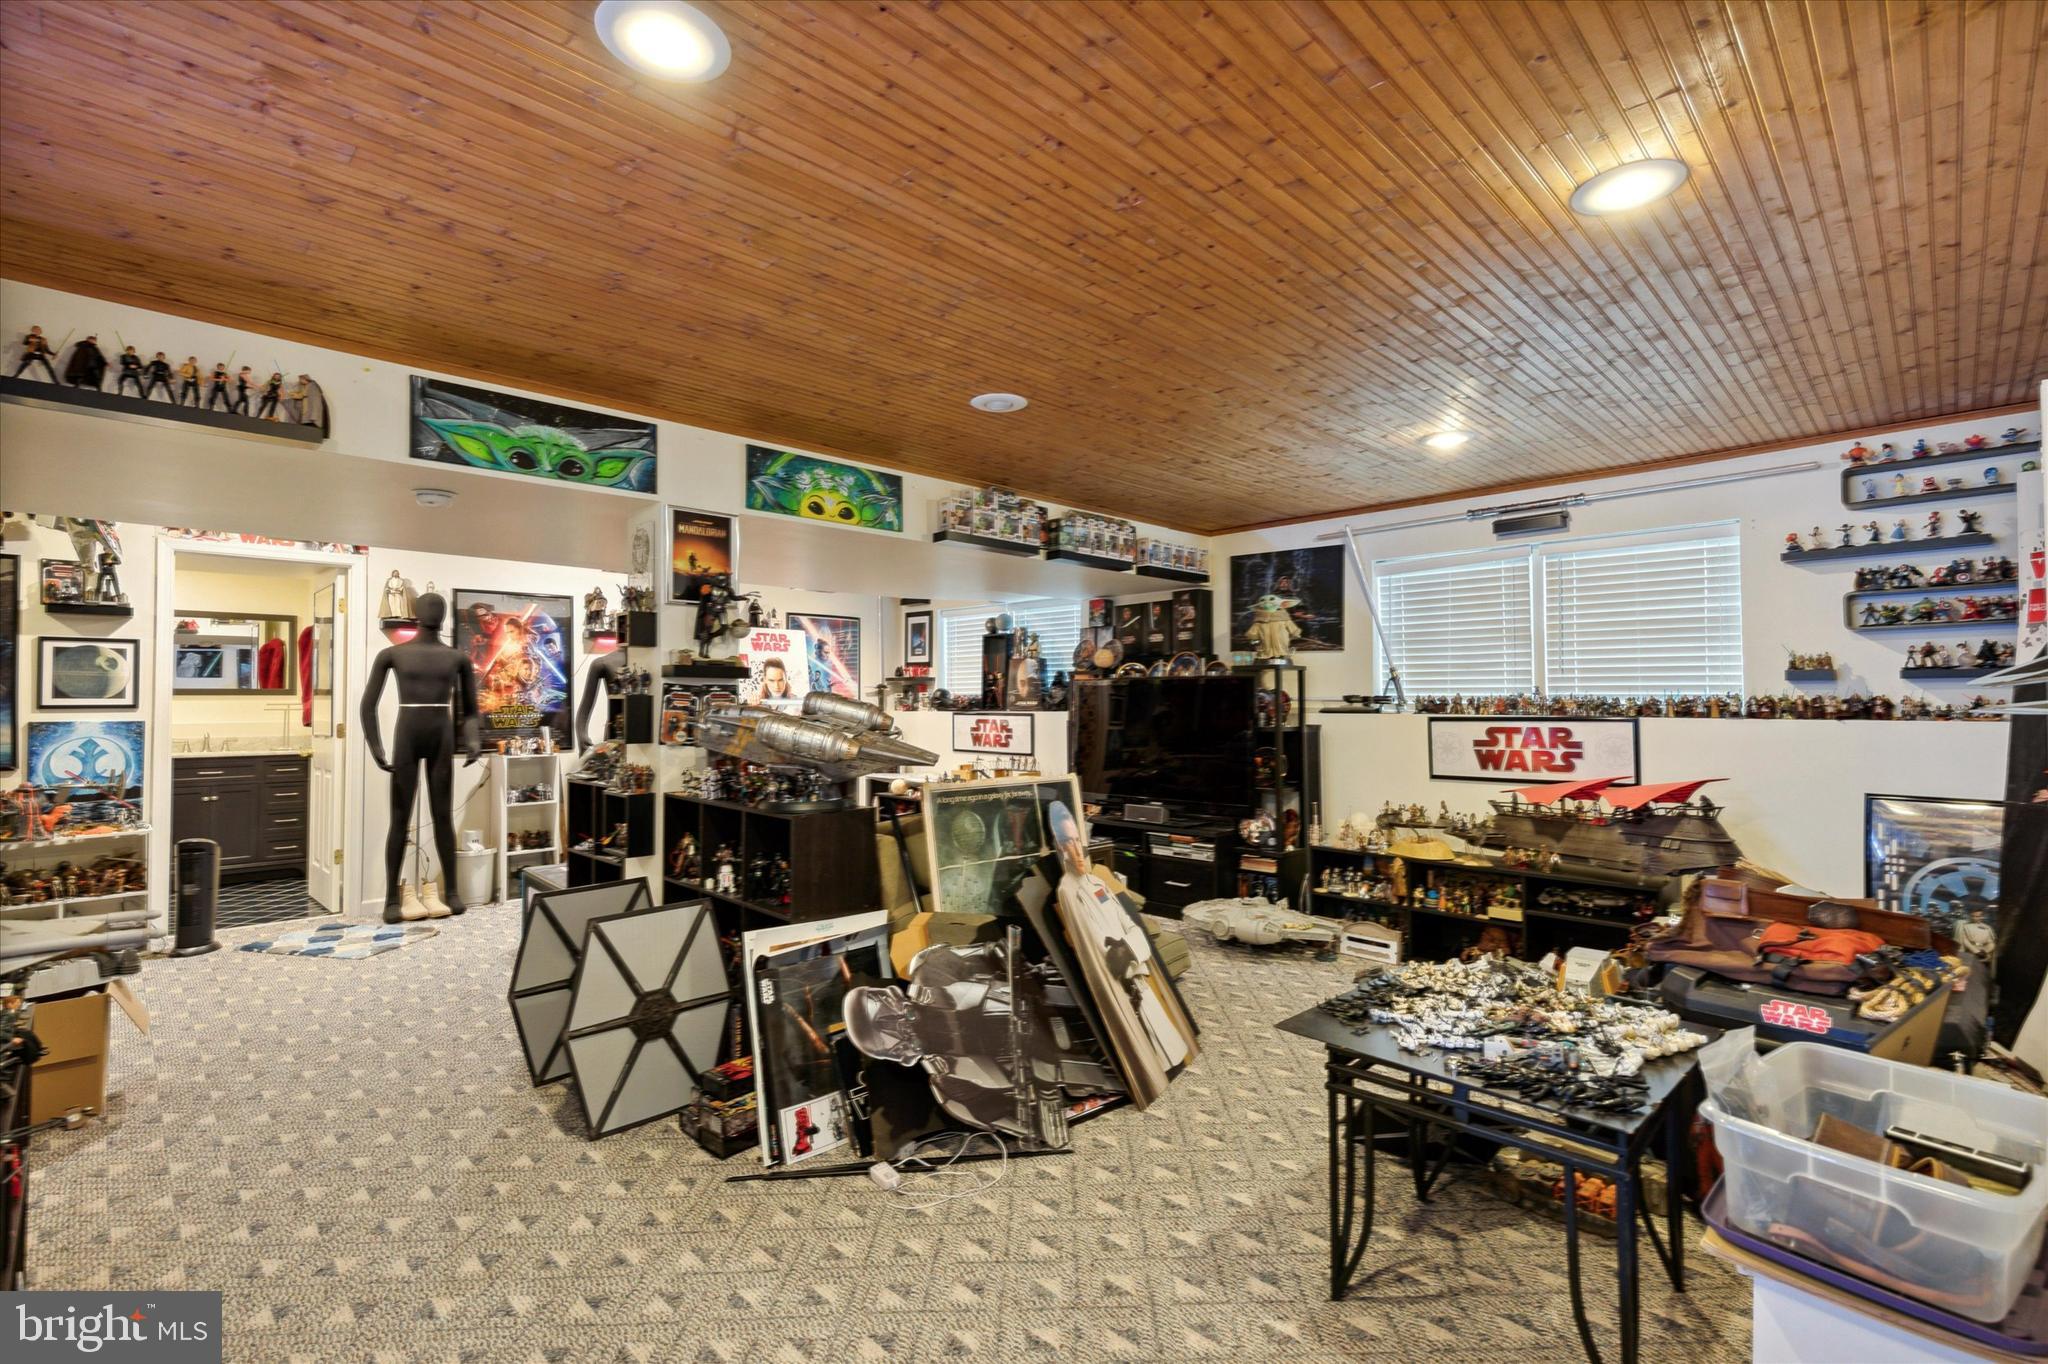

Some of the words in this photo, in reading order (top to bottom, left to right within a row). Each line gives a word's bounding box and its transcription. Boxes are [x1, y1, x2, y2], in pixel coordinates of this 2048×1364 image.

[678, 523, 727, 537] MANDALORIAN
[751, 632, 791, 643] STAR
[751, 642, 791, 652] WARS
[492, 704, 540, 714] STAR
[492, 717, 541, 729] WARS
[970, 718, 1013, 733] STAR
[970, 733, 1013, 748] WARS
[1472, 726, 1584, 750] STAR
[1473, 749, 1584, 773] WARS
[1761, 999, 1832, 1023] STAR
[1762, 1008, 1832, 1034] WARS
